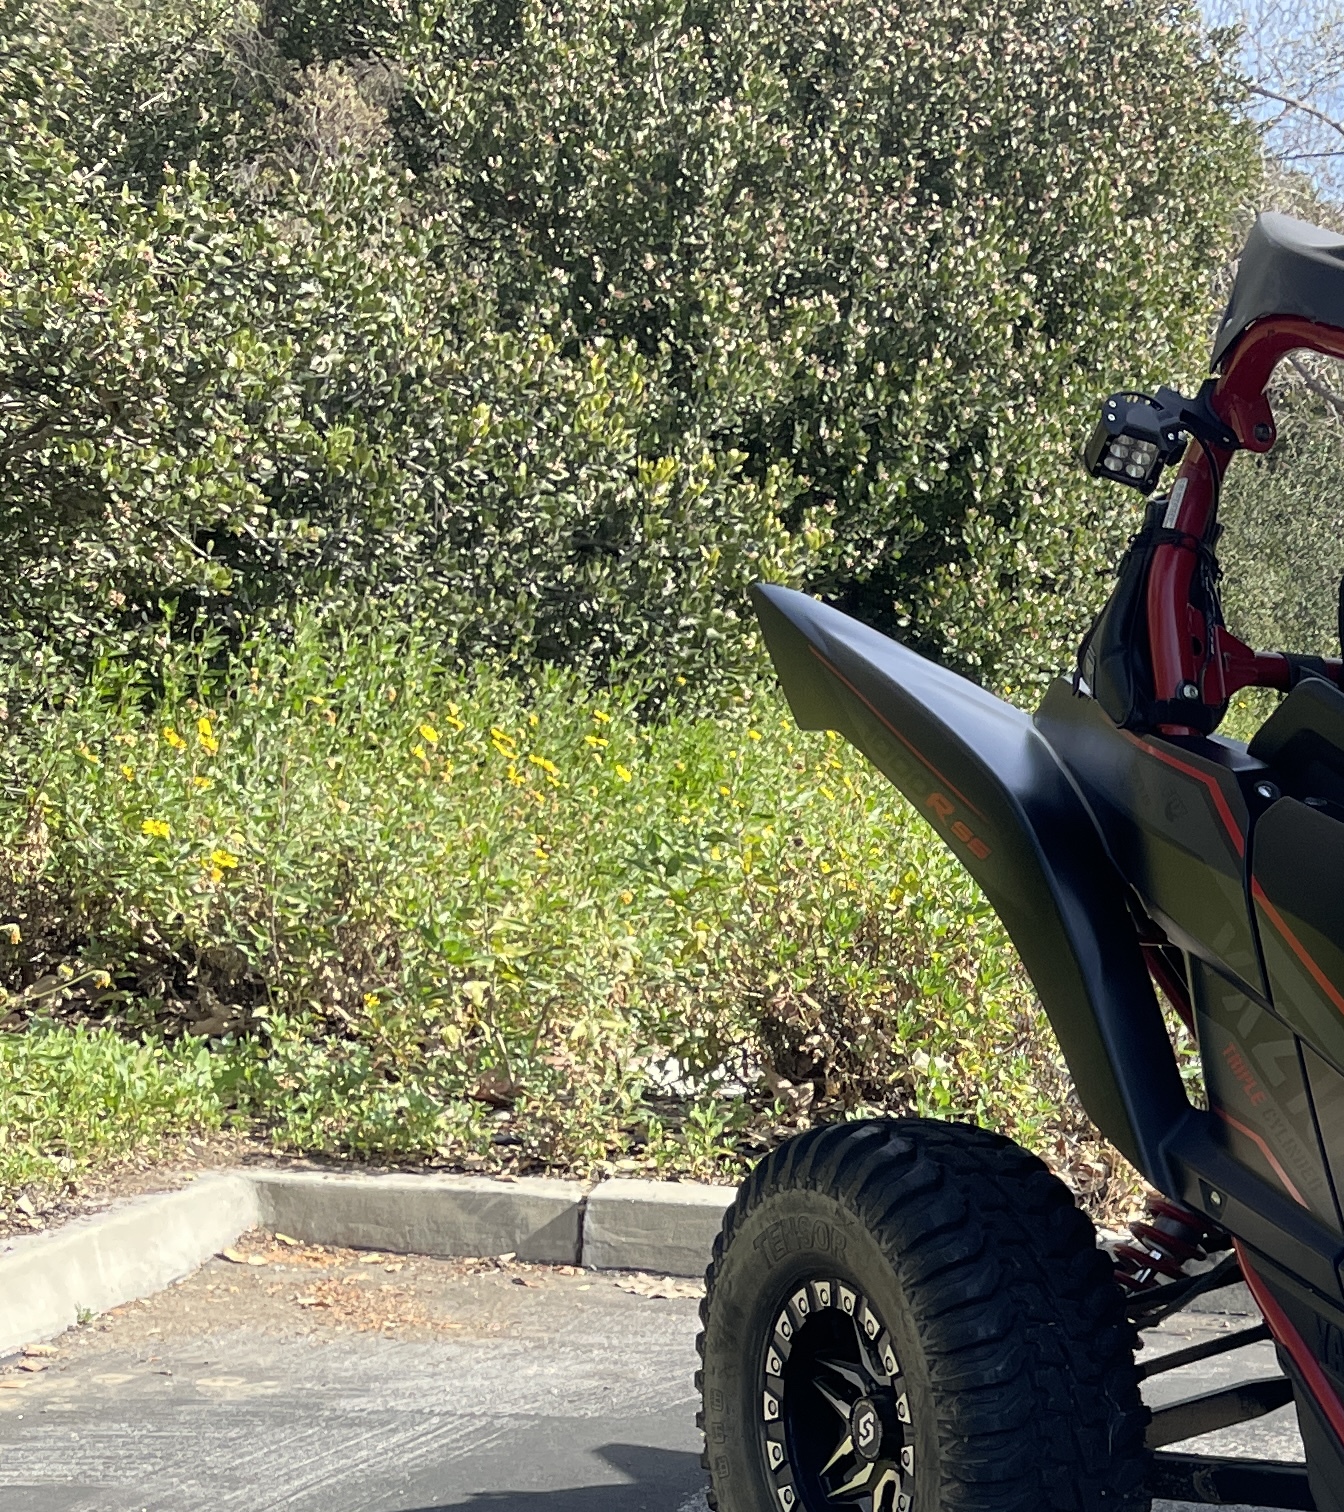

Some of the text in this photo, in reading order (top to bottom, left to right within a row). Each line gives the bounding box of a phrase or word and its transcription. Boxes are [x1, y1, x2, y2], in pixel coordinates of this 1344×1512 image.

[1222, 1041, 1324, 1193] TRIPLE CYLINDER
[753, 1215, 847, 1269] TENSOR
